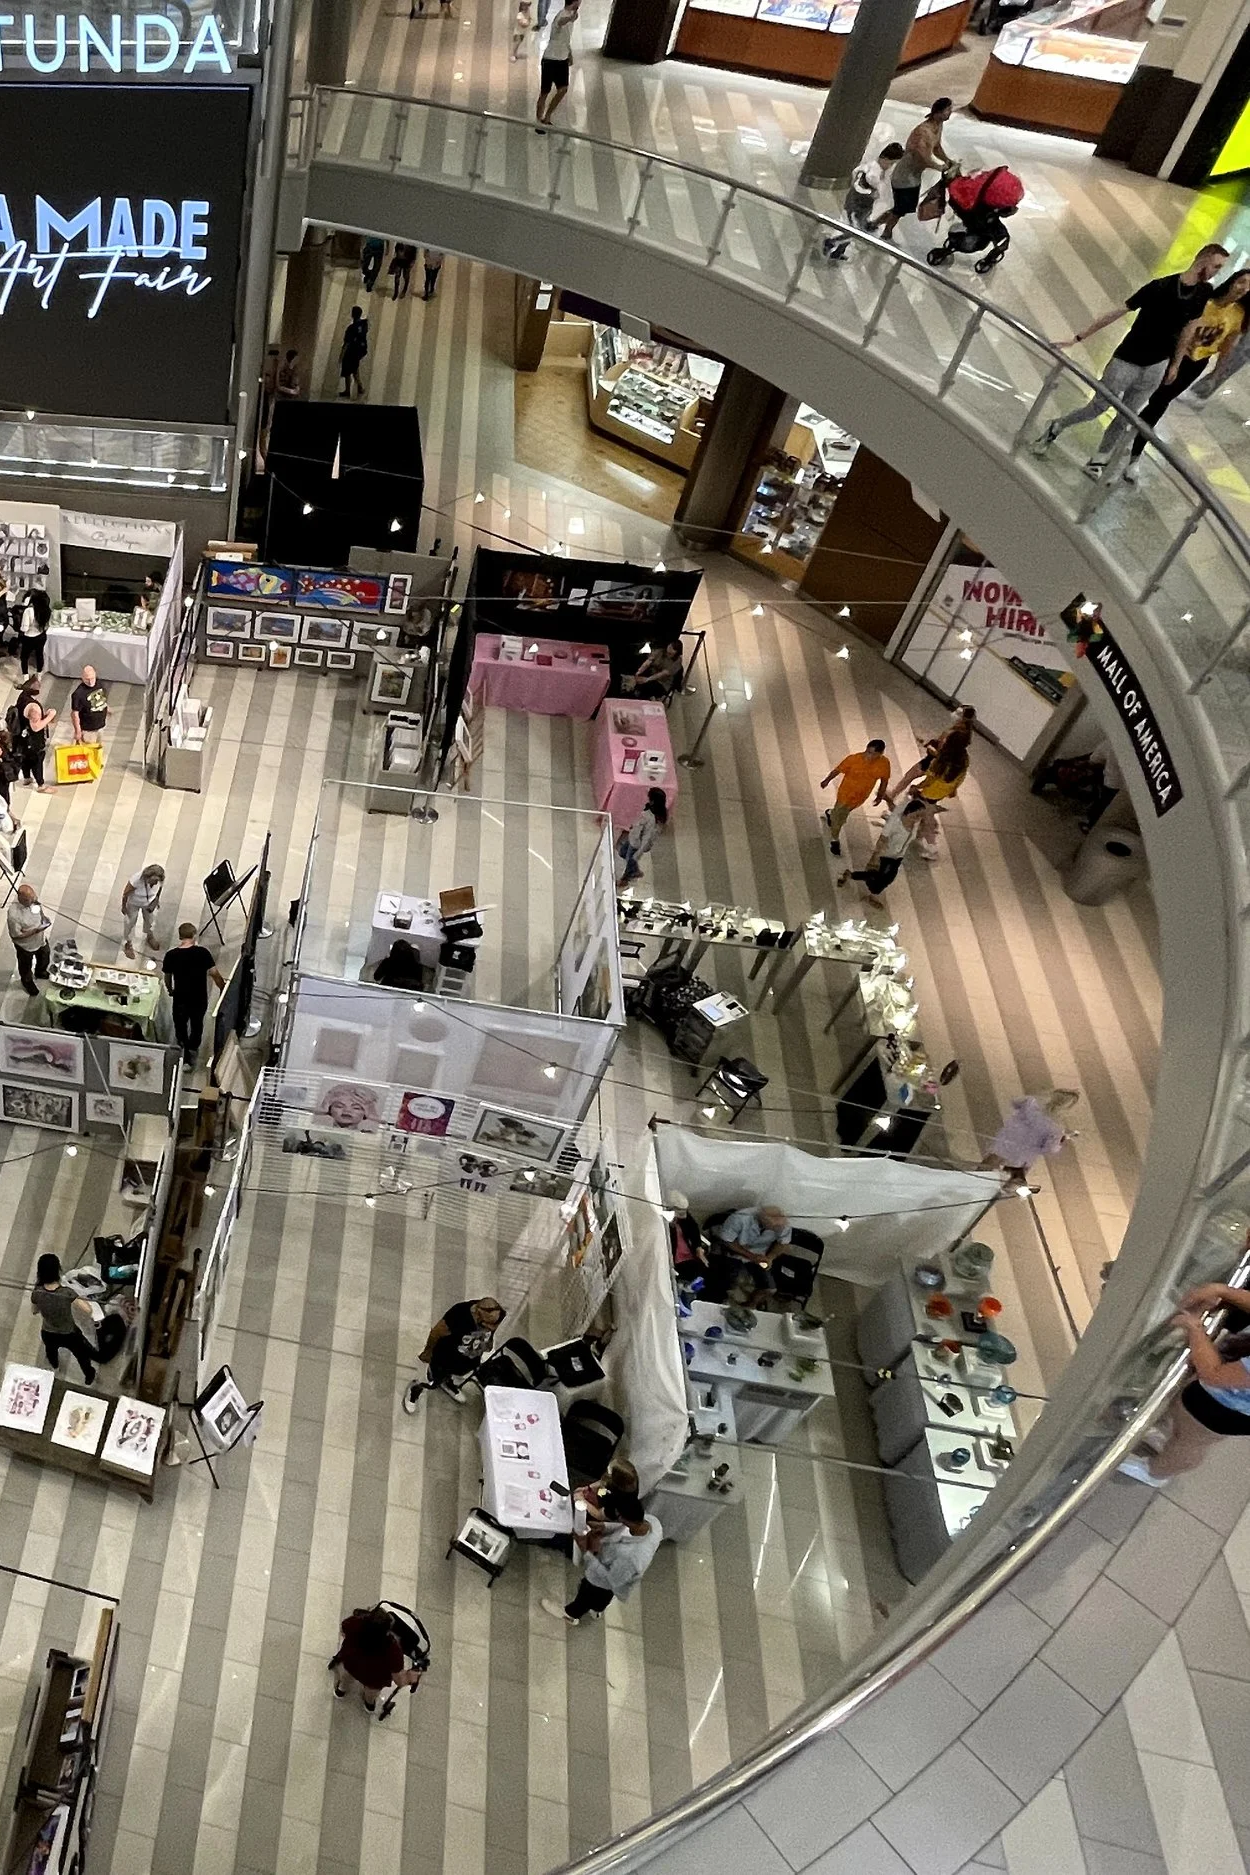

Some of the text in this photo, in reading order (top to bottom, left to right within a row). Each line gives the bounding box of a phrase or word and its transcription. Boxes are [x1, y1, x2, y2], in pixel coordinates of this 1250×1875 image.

[35, 193, 210, 261] MADE
[79, 244, 212, 318] Fair
[1096, 645, 1173, 805] MALL OF AMERICA
